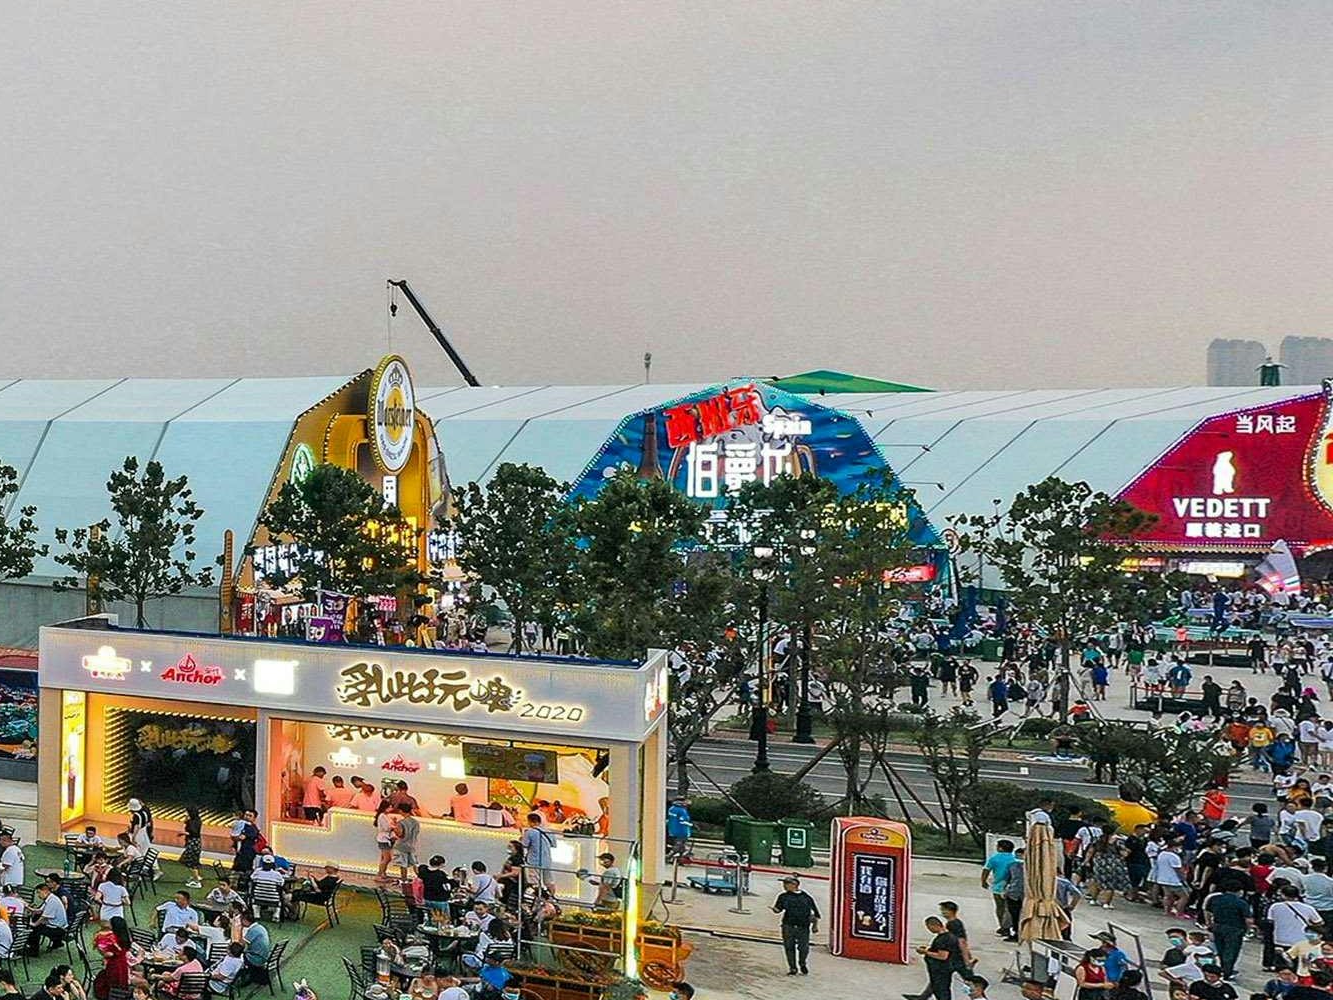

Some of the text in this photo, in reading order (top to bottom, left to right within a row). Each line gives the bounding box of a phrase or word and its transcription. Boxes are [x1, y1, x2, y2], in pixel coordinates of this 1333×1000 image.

[1235, 415, 1297, 434] 当风起
[1172, 497, 1271, 518] VEDETT
[161, 667, 222, 685] Anchor
[520, 703, 584, 722] 2020
[381, 759, 421, 775] Anchor
